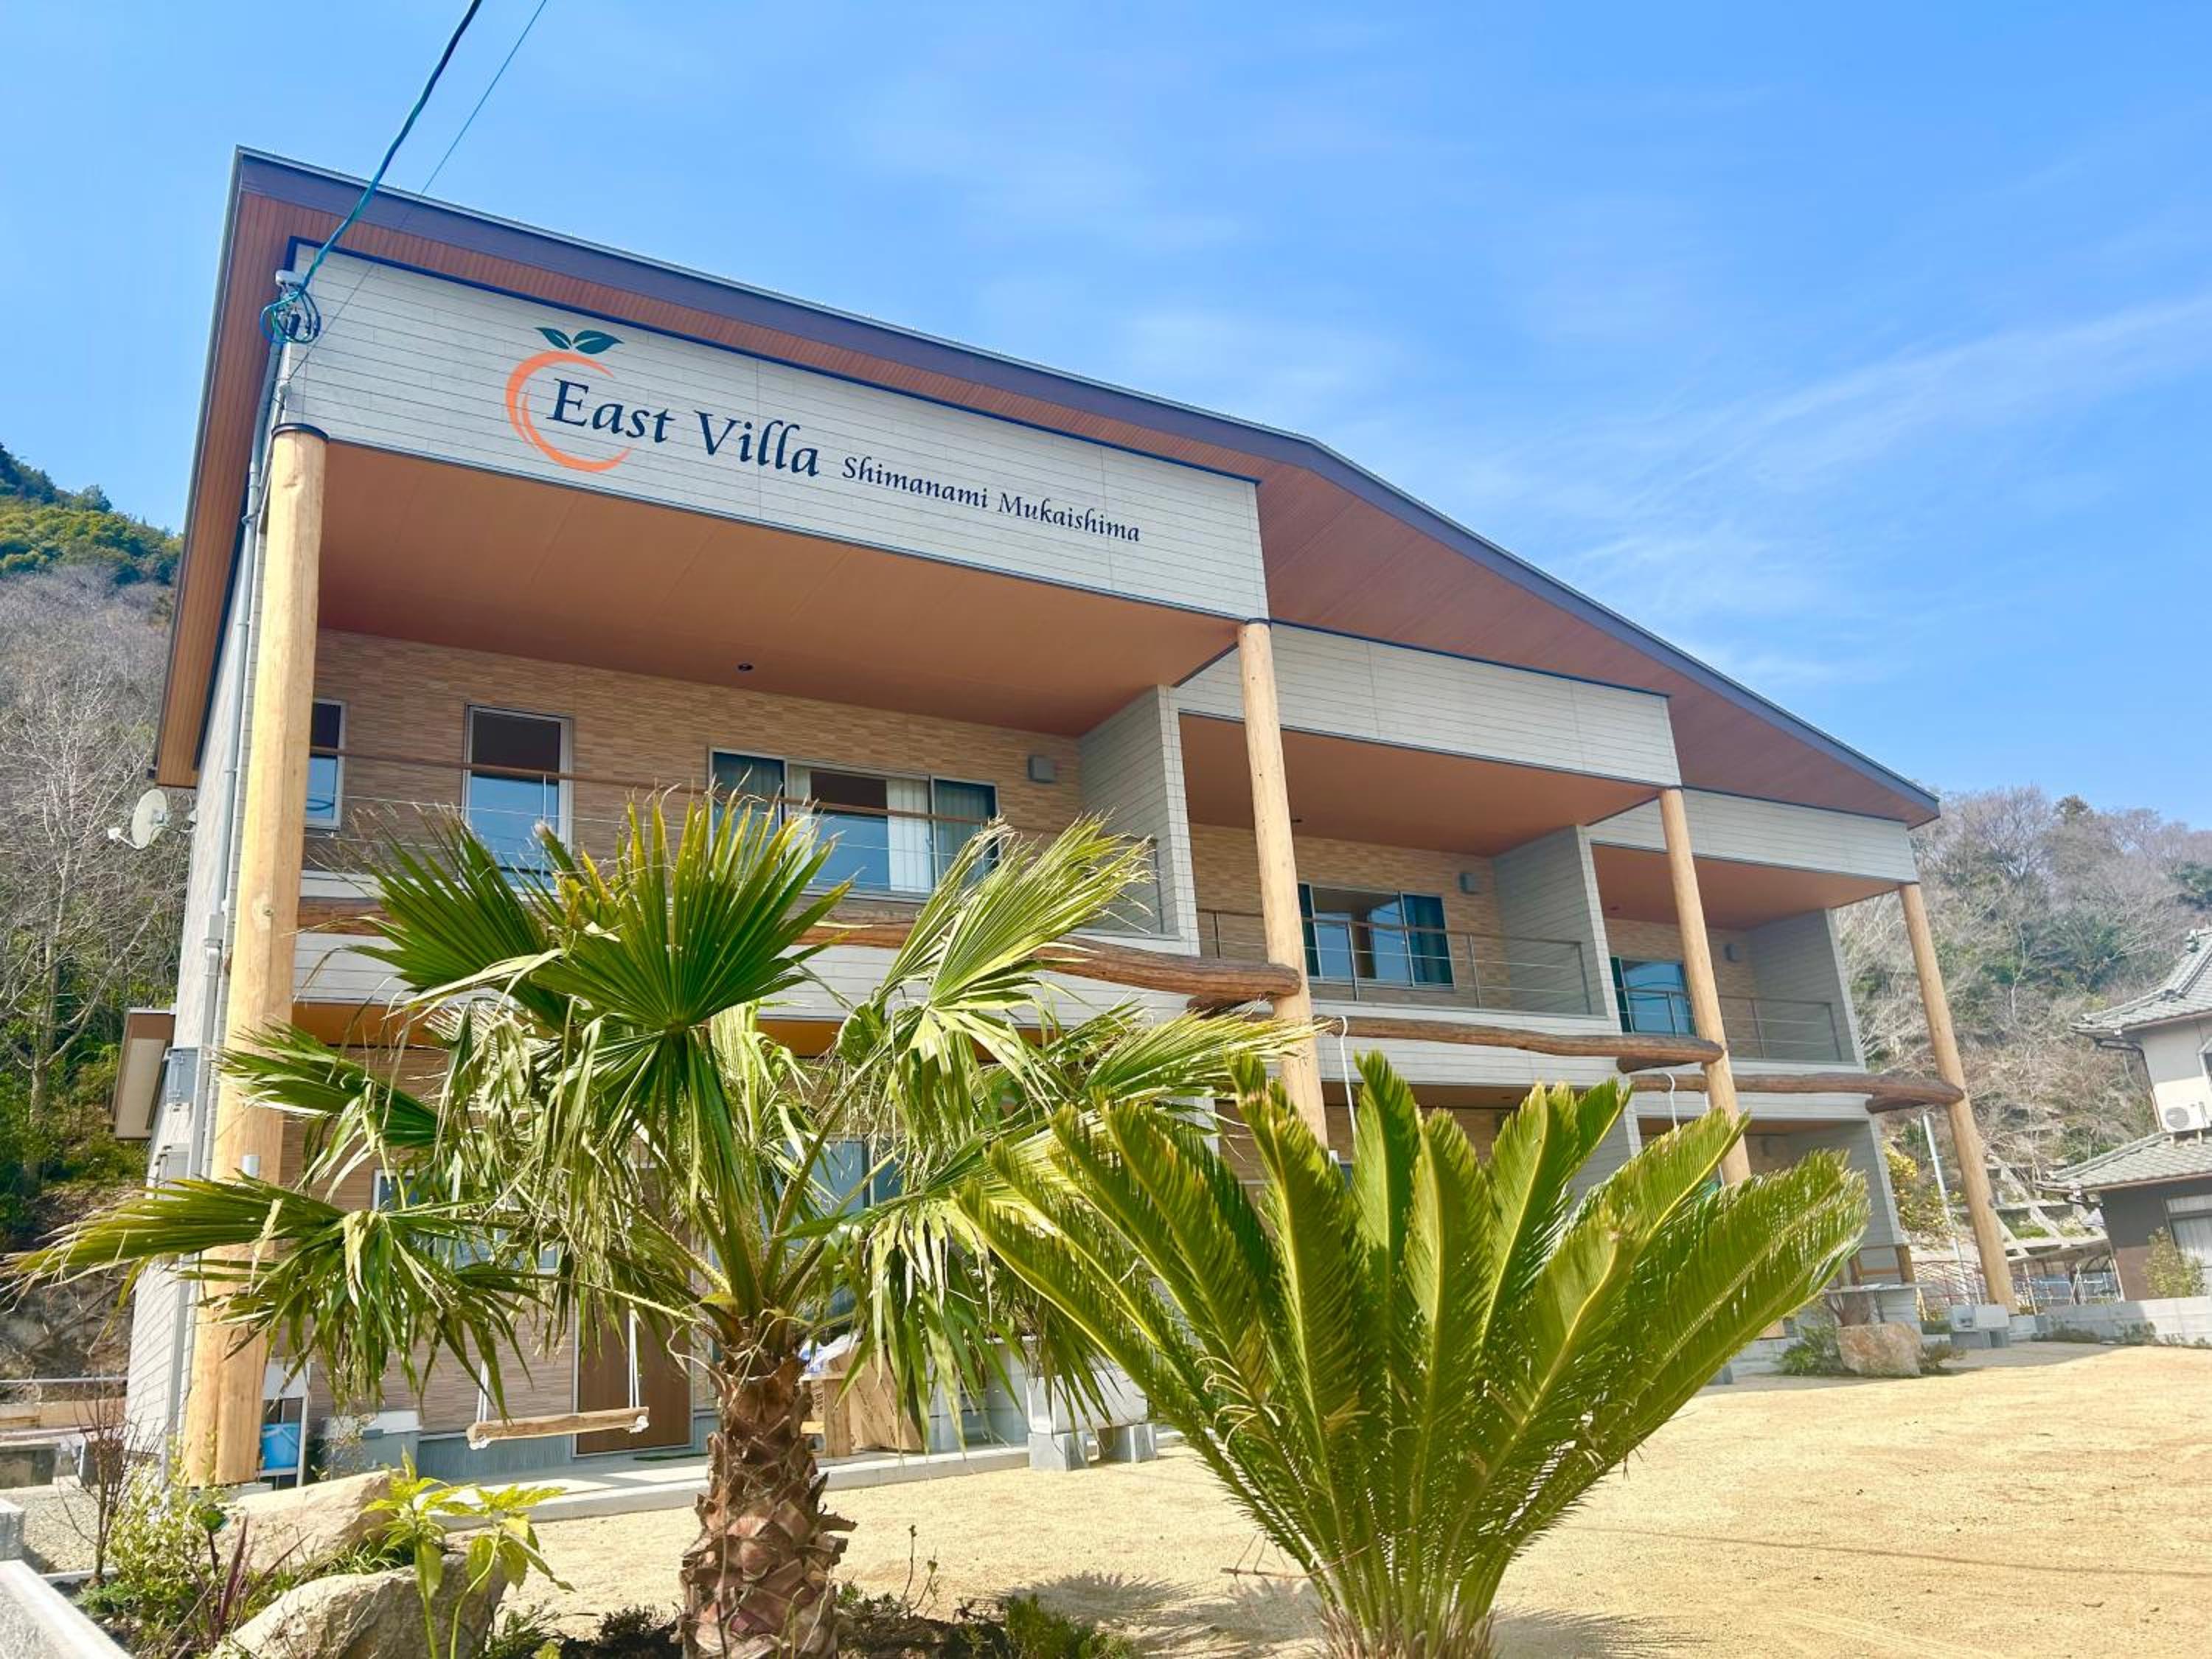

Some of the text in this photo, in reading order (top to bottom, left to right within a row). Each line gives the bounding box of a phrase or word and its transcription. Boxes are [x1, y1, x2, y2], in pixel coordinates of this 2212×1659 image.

[546, 378, 821, 478] East Villa
[841, 456, 1141, 543] Shimanami Mukaishima
